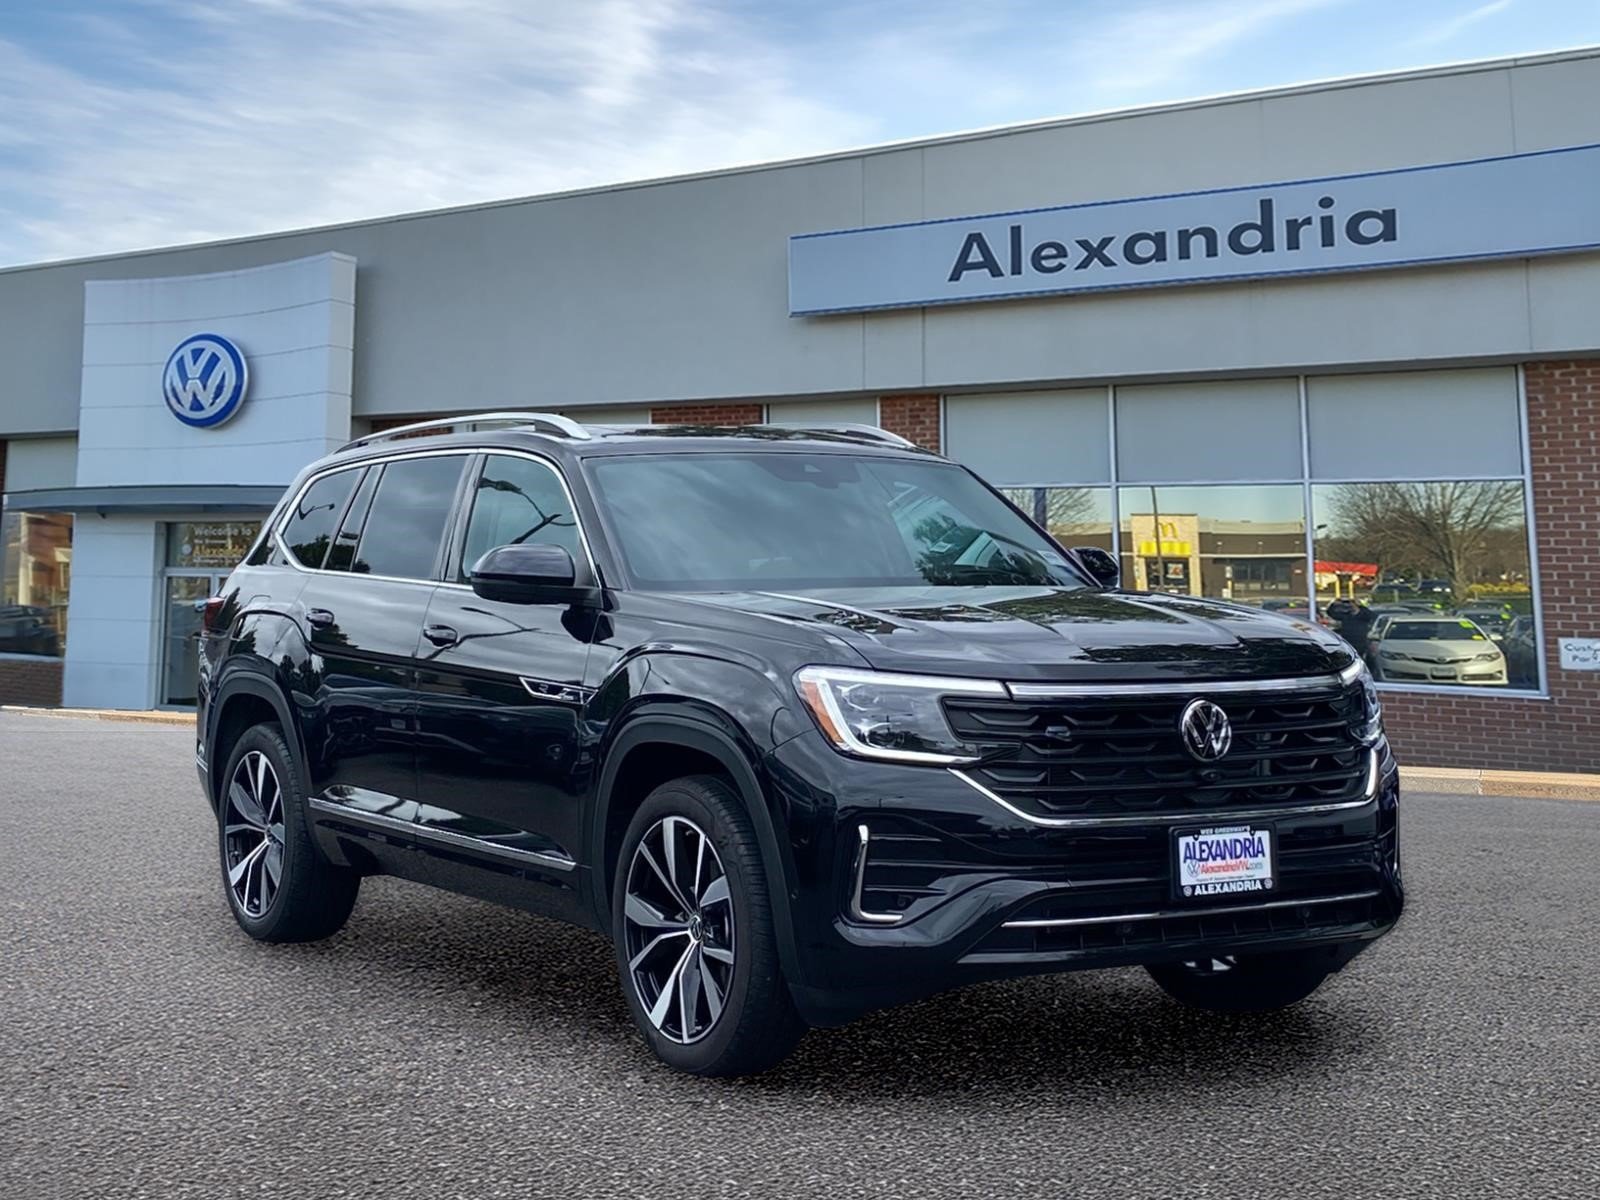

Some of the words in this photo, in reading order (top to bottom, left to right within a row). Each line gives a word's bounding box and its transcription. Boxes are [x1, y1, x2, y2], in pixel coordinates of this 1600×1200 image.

[946, 195, 1398, 283] Alexandria
[1184, 837, 1265, 863] ALEXANDRIA
[1195, 880, 1262, 895] ALEXANDRIA
